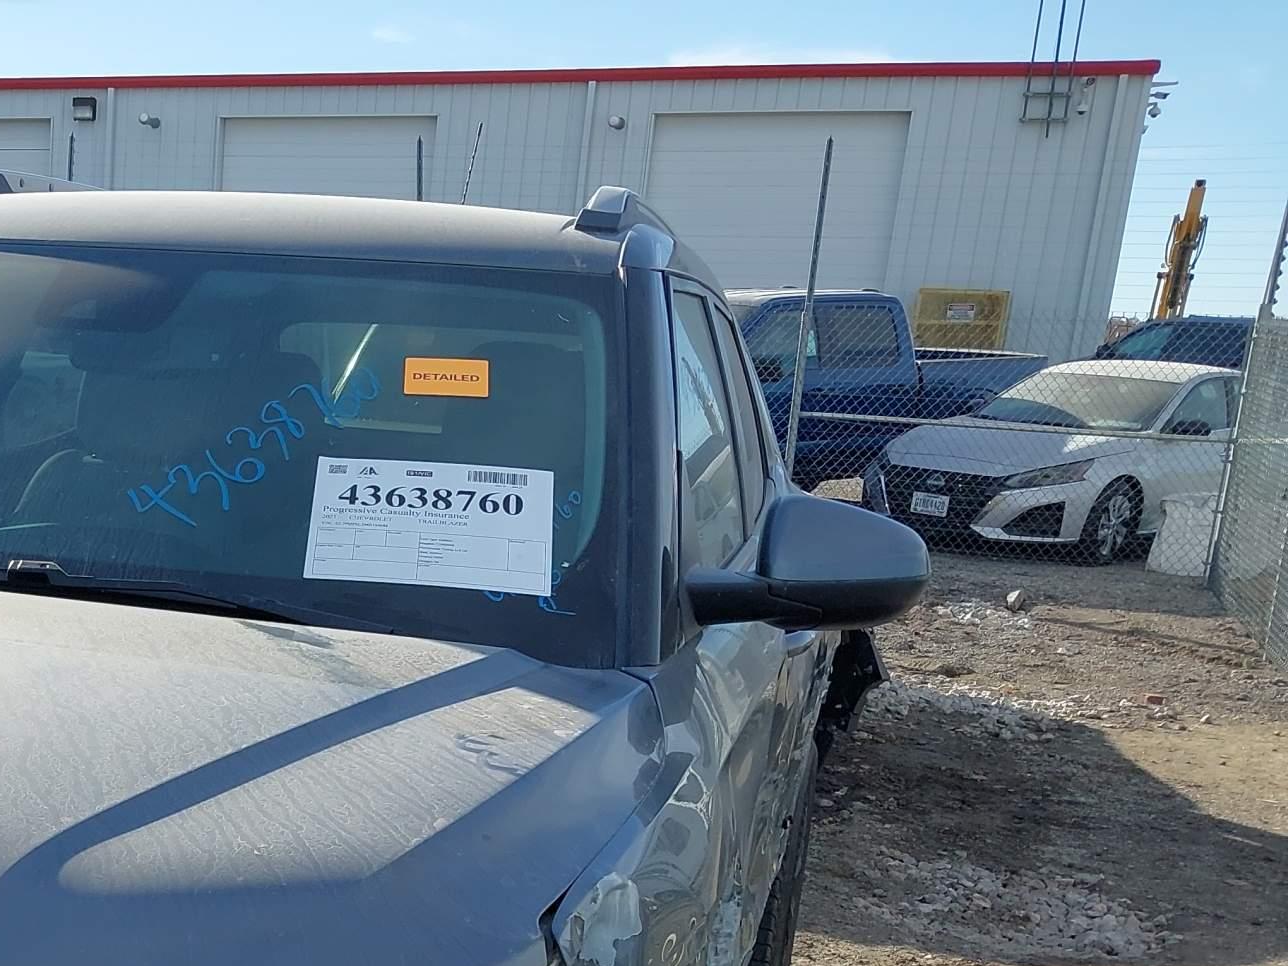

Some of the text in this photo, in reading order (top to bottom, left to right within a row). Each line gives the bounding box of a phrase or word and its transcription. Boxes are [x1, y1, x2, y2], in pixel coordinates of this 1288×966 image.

[412, 371, 480, 382] DETAILED
[338, 483, 524, 516] 43638760
[323, 505, 470, 520] Progressive Casualty Insurance
[418, 519, 468, 527] TRAILBLAZER
